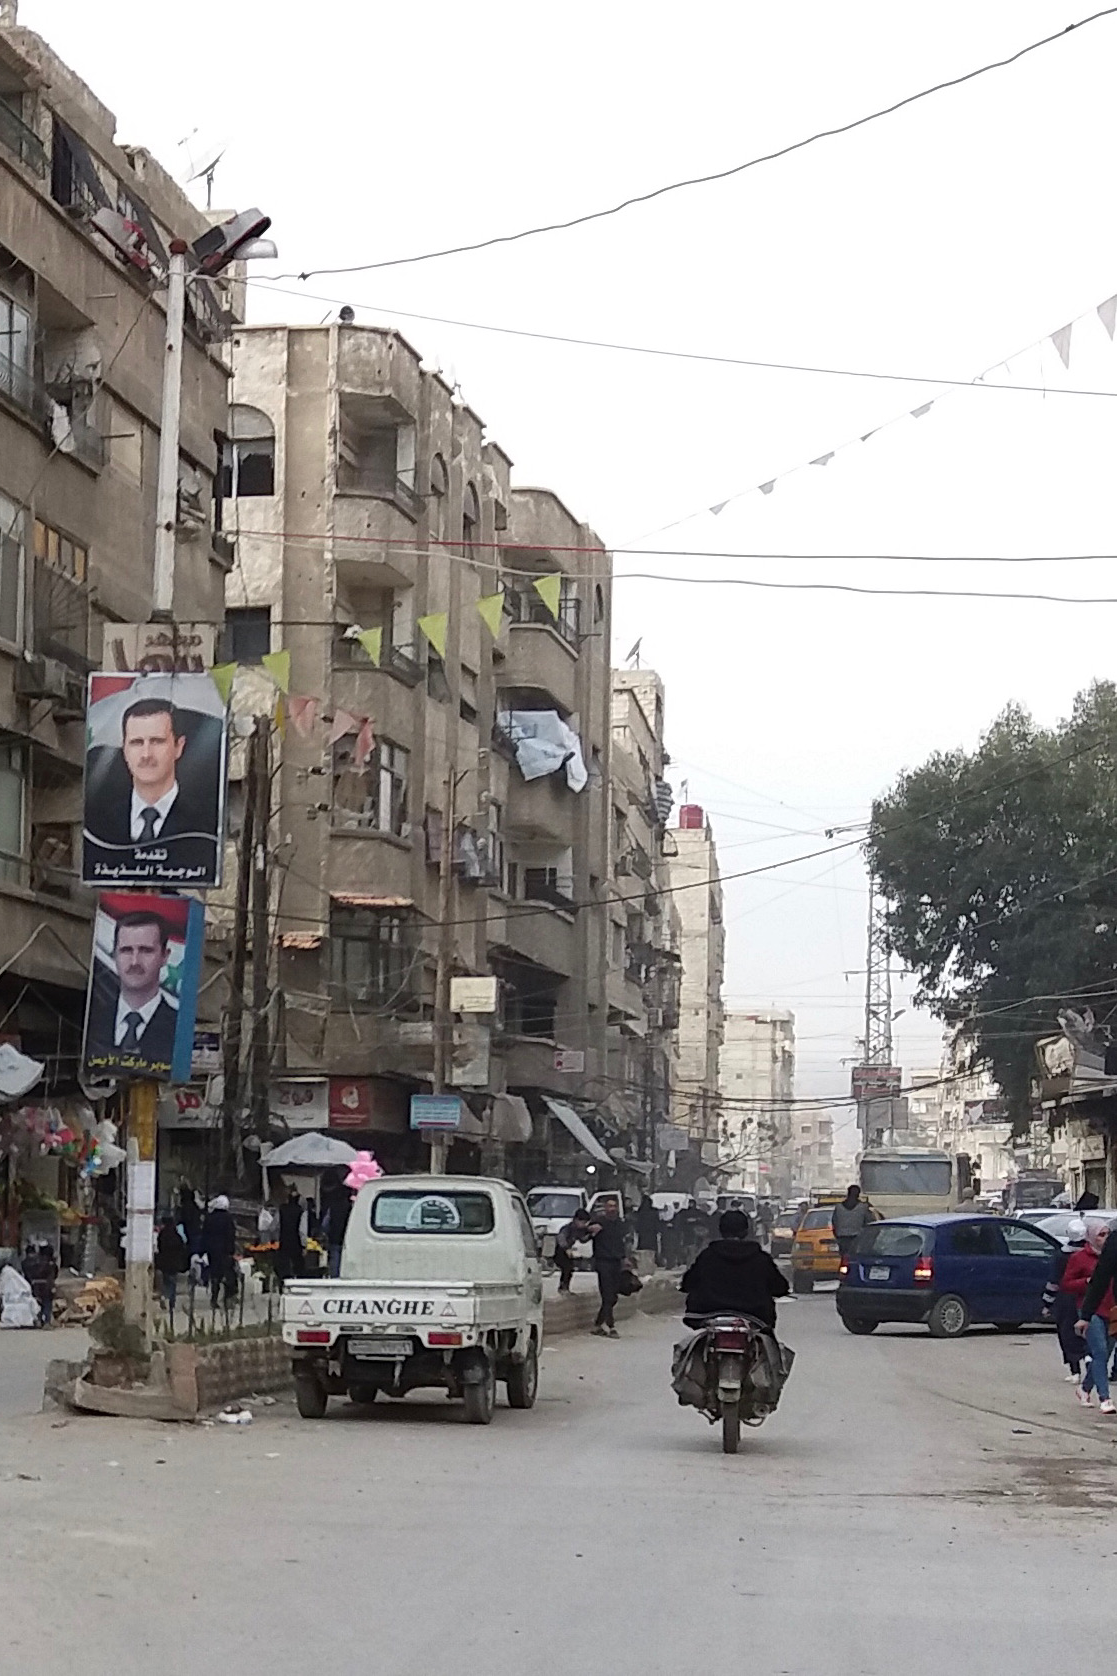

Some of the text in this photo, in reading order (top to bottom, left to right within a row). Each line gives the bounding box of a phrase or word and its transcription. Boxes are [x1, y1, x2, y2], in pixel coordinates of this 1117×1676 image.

[94, 863, 207, 879] الوجبة اللذيذة
[323, 1299, 435, 1315] CHANGHE
